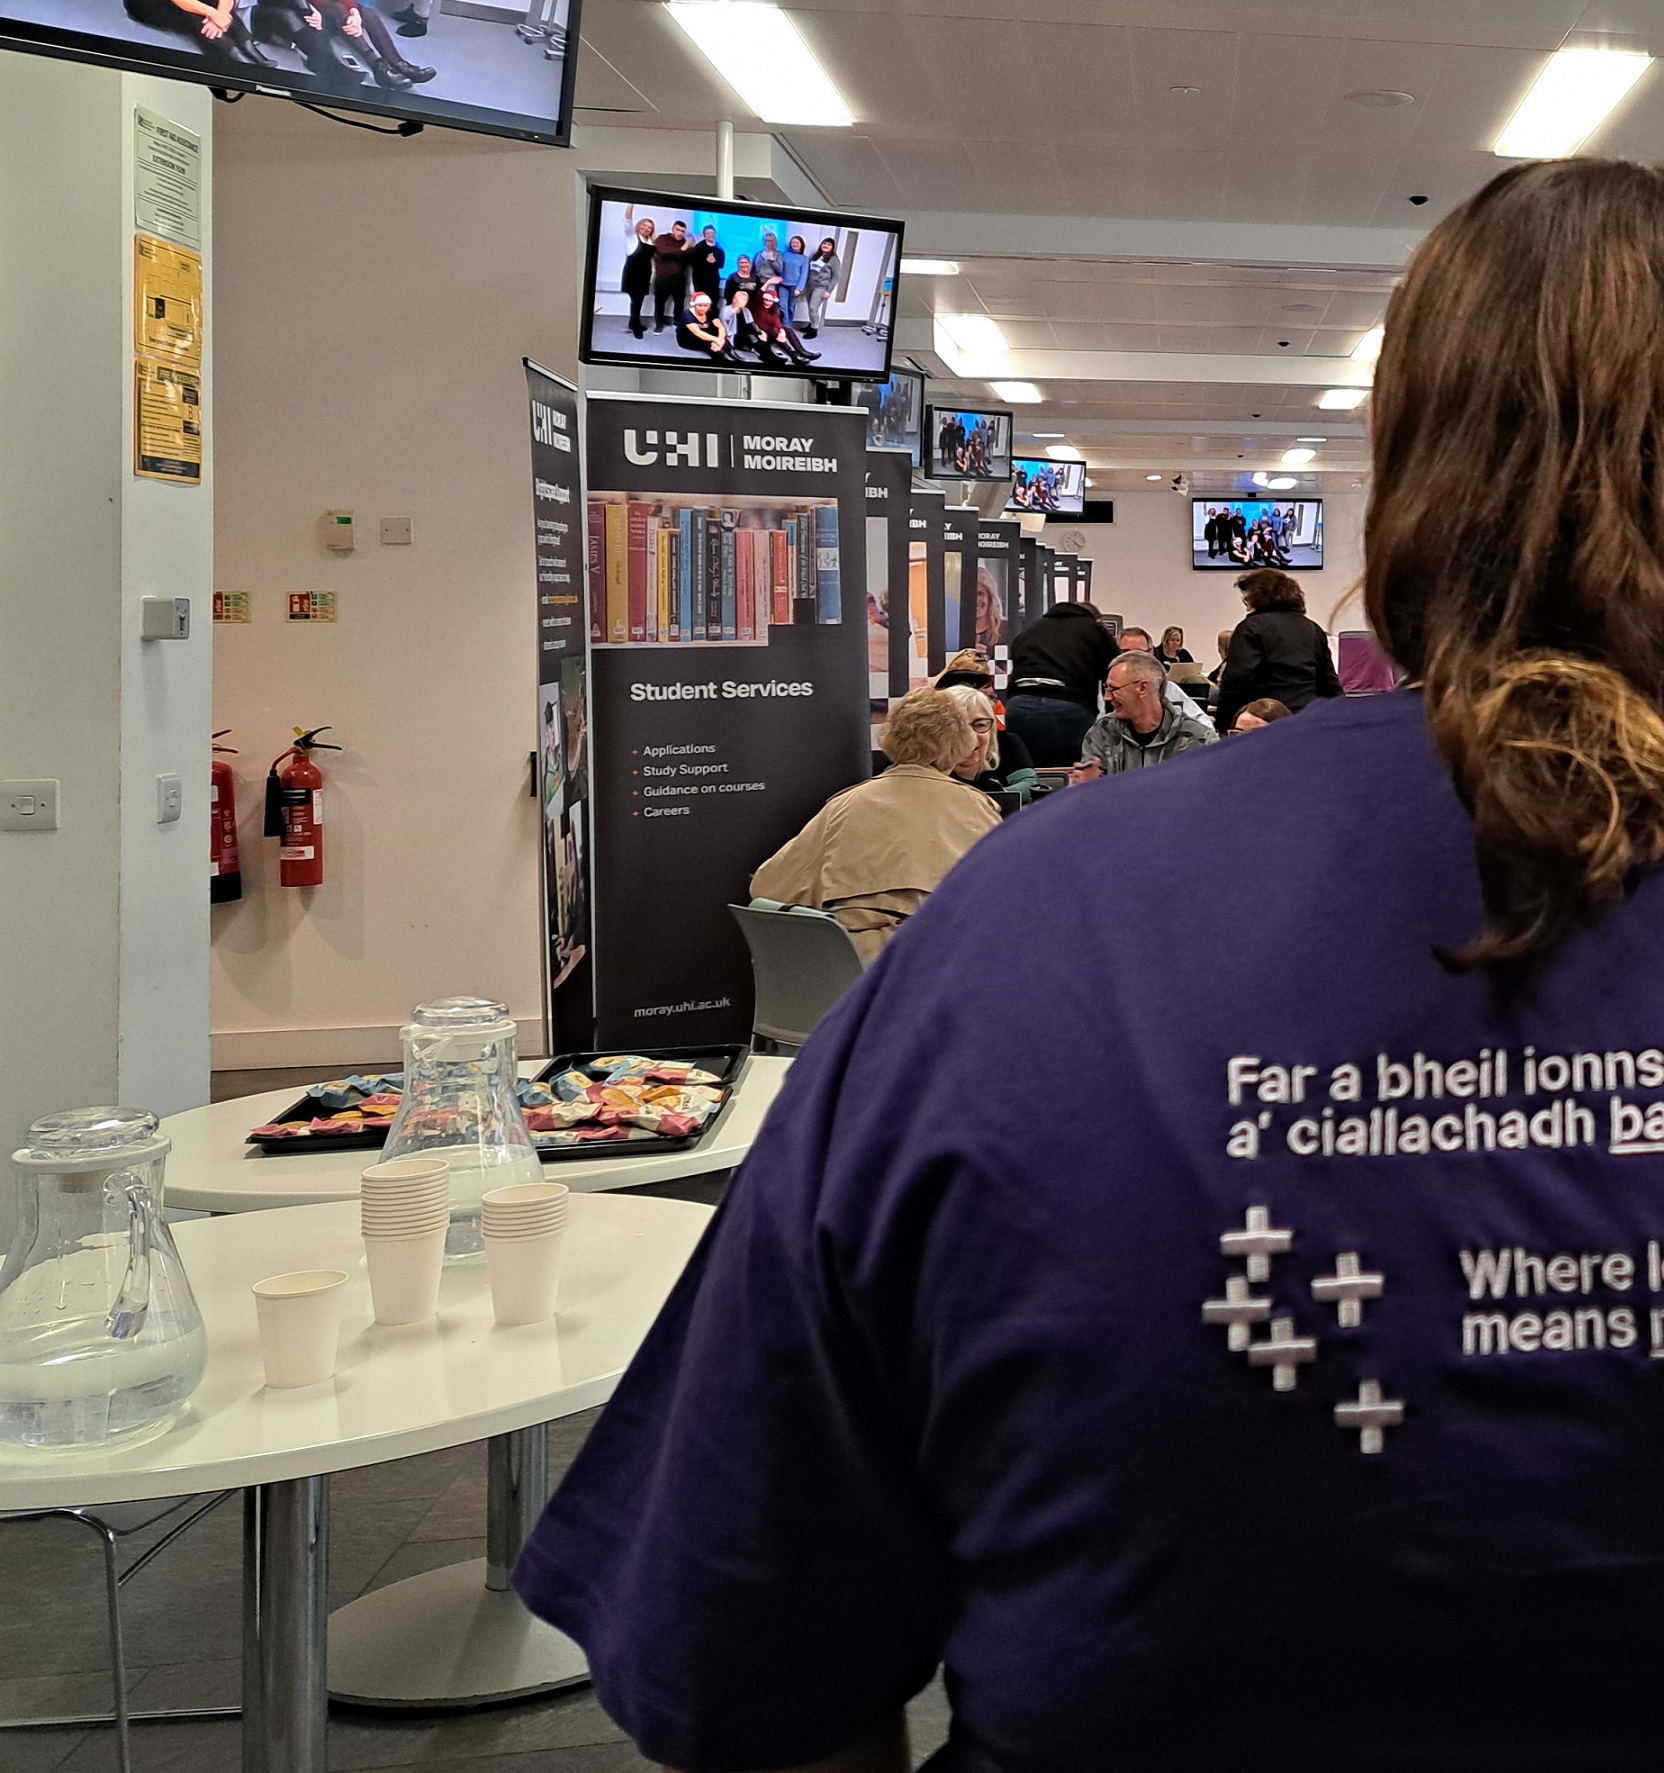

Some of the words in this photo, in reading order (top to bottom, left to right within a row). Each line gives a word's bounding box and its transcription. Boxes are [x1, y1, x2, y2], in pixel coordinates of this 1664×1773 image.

[624, 428, 719, 468] UHI
[743, 435, 814, 453] MORAY
[743, 454, 838, 473] MOIREIBH
[630, 681, 718, 701] Student
[721, 680, 814, 700] Services
[643, 743, 716, 757] Applications
[643, 765, 678, 779] Study
[679, 763, 729, 777] Support
[643, 784, 699, 798] Guidance
[701, 784, 717, 794] on
[718, 781, 766, 793] courses
[643, 805, 690, 819] Careers
[633, 996, 732, 1019] moray.uhi.ac.uk
[1227, 1055, 1317, 1106] Far
[1329, 1063, 1362, 1103] a
[1377, 1049, 1508, 1101] bheil
[1227, 1111, 1272, 1159] a'
[1286, 1100, 1597, 1158] ciallachadh
[1460, 1247, 1635, 1300] Where
[1461, 1306, 1636, 1356] means
